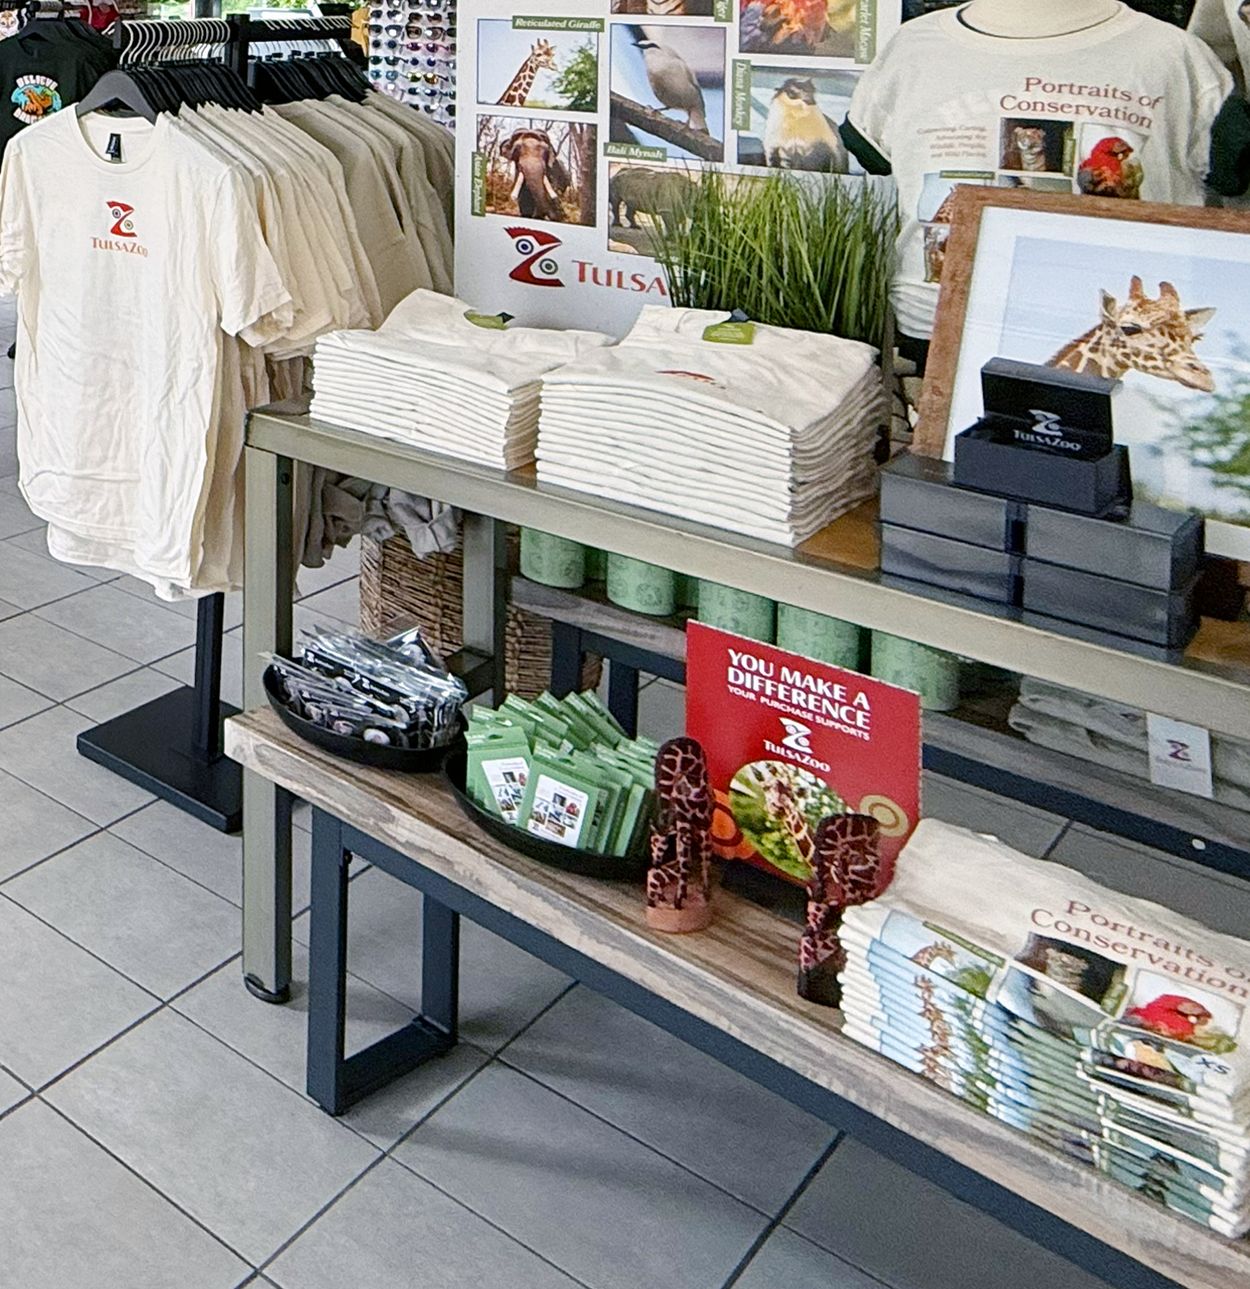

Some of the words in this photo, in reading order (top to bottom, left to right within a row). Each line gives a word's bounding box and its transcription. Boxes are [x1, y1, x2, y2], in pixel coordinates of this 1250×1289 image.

[514, 18, 566, 29] Reticulated
[568, 19, 601, 30] Giraffe
[858, 25, 872, 59] Macaw
[735, 62, 747, 89] Diana
[733, 90, 747, 127] Monkey
[999, 94, 1154, 129] Conservation
[1024, 77, 1133, 102] Portraits
[1138, 95, 1165, 111] of
[606, 145, 629, 156] Bali
[630, 147, 664, 161] Mynah
[727, 648, 774, 677] YOU
[781, 666, 848, 703] MAKE
[852, 691, 871, 710] A
[726, 684, 756, 702] YOUR
[760, 696, 814, 721] PURCHASE
[815, 714, 870, 742] SUPPORTS
[727, 666, 871, 730] DIFFERENCE
[1030, 908, 1248, 998] Conservation
[1066, 899, 1214, 968] Portraits
[1225, 966, 1250, 983] o
[1195, 1056, 1231, 1075] XS
